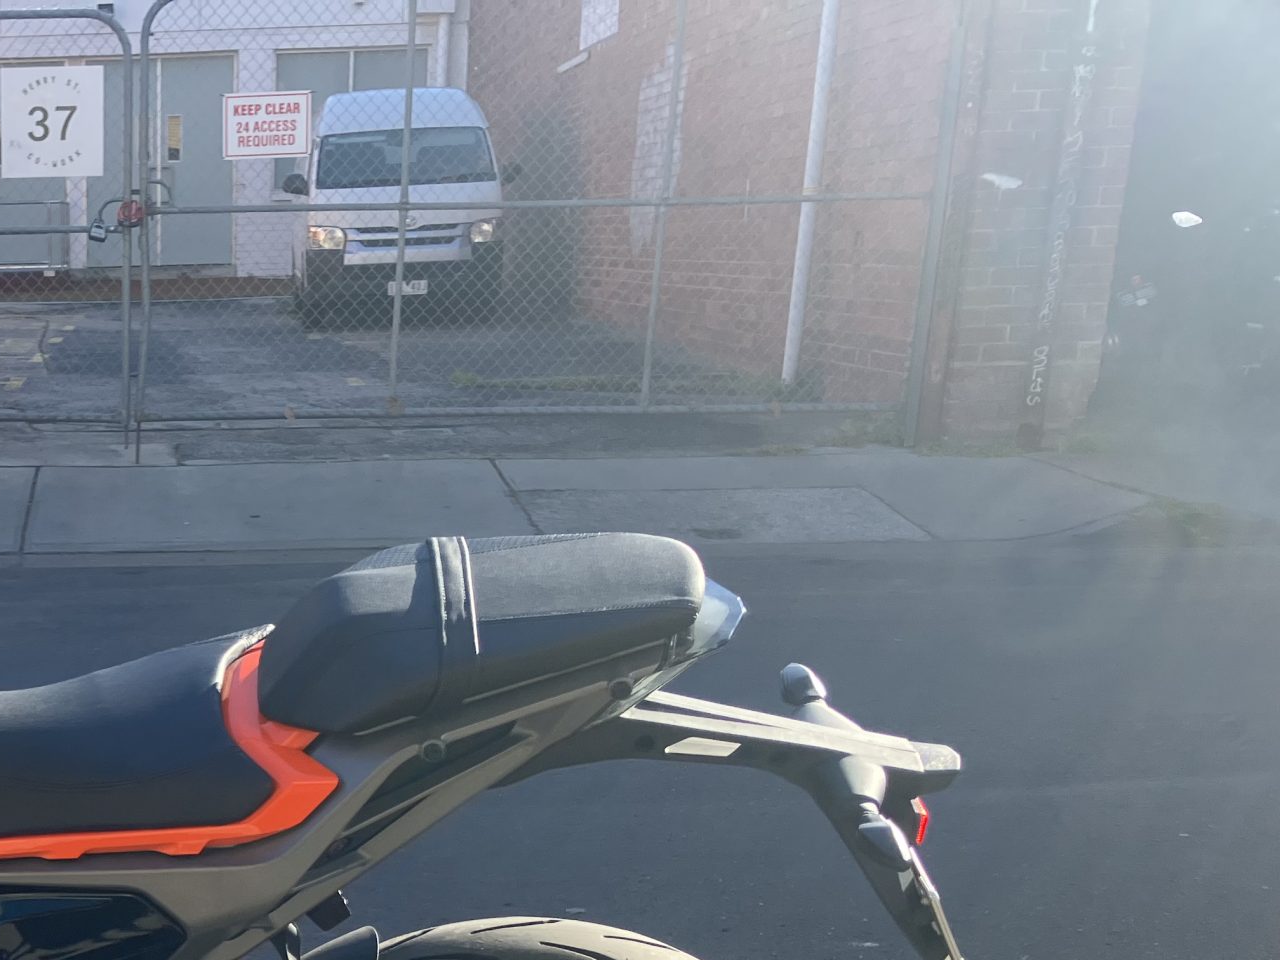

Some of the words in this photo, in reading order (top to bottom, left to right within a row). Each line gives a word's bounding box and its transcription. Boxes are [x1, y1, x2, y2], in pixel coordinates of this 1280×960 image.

[233, 104, 261, 116] KEEP
[265, 102, 300, 115] CLEAR
[27, 105, 78, 142] 37
[236, 121, 249, 133] 24
[253, 120, 297, 133] ACCESS
[237, 134, 296, 147] REQUIRED
